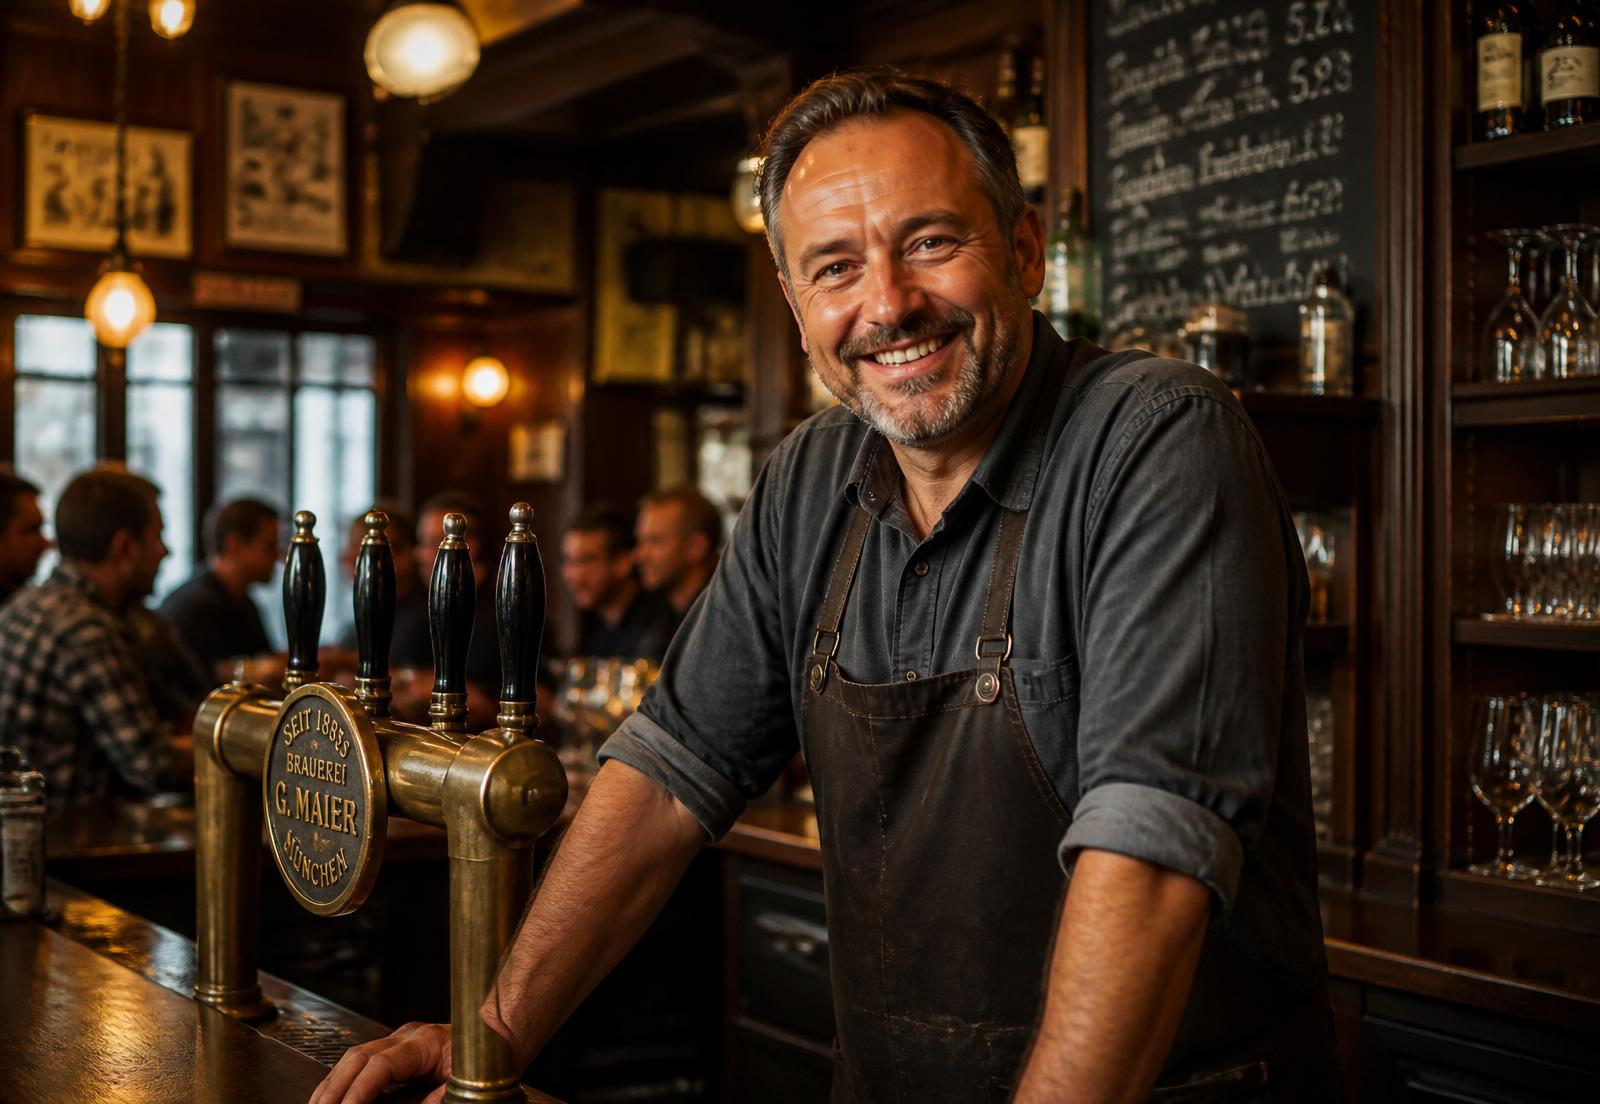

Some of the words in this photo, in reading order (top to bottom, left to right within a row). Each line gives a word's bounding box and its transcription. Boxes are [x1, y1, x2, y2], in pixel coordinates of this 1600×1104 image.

[283, 708, 311, 746] SEIT
[286, 752, 347, 786] BRAUEREI
[275, 780, 291, 817] G.
[295, 786, 357, 836] MAIER
